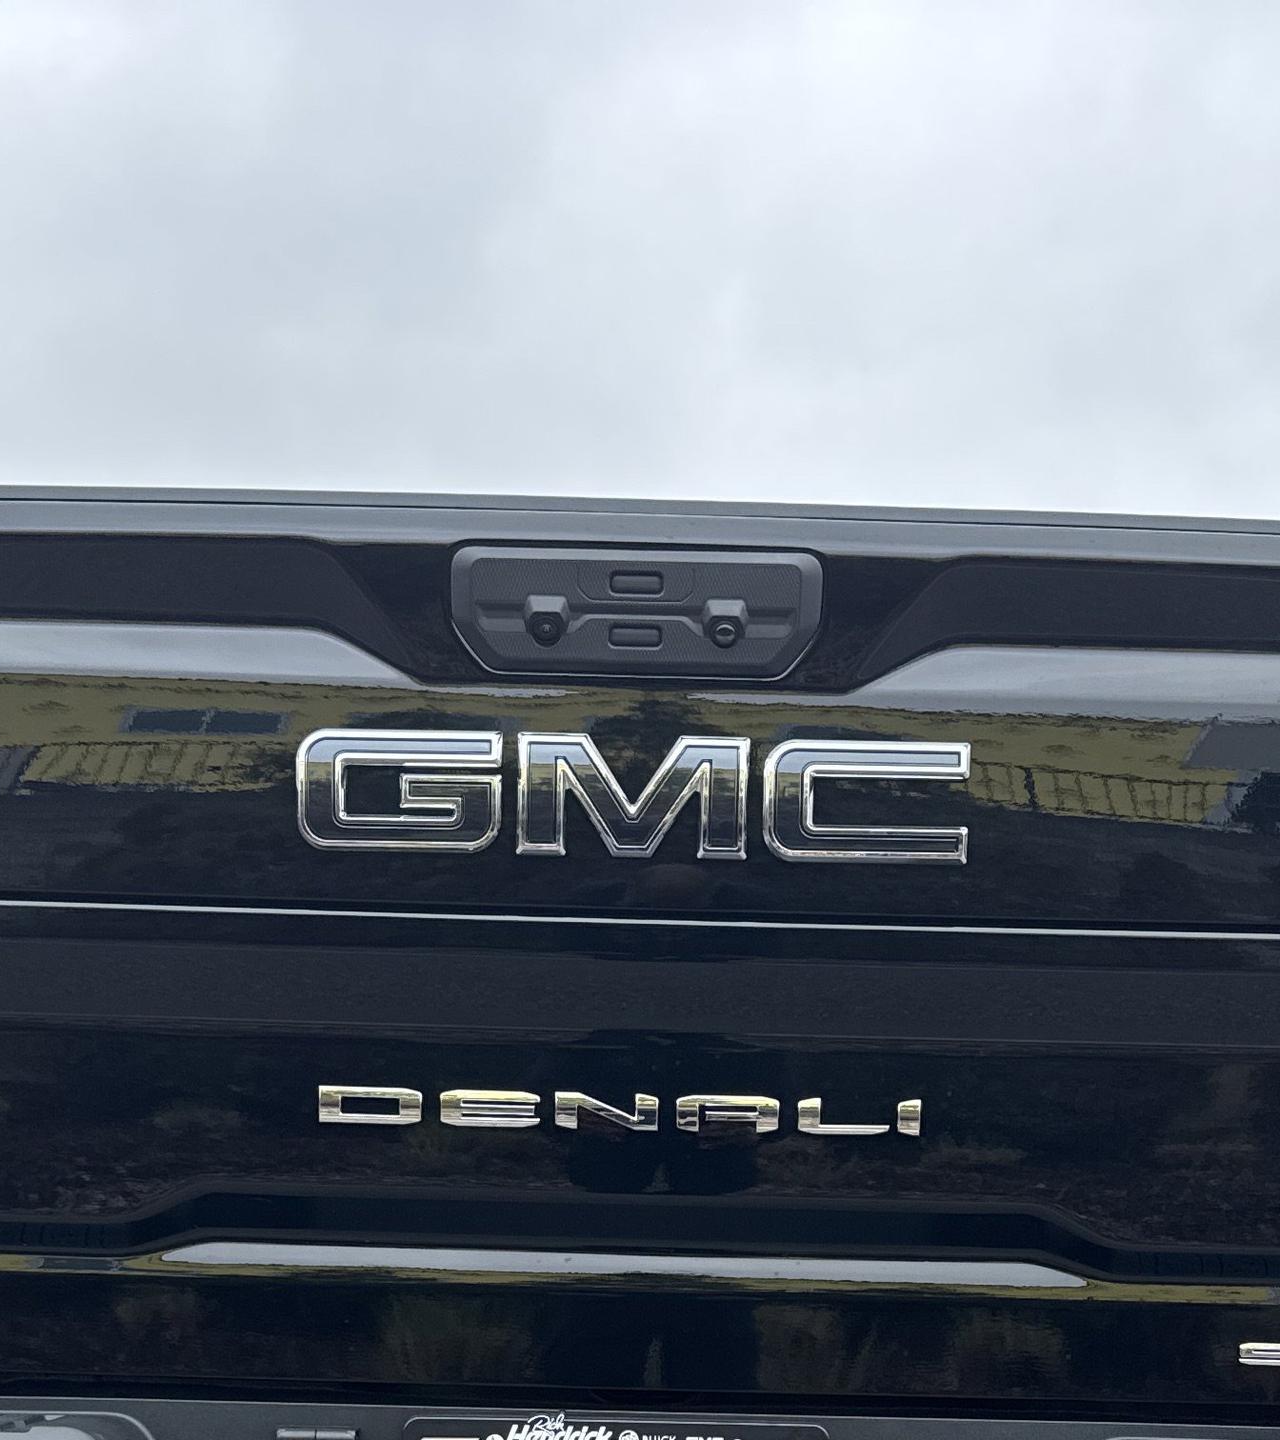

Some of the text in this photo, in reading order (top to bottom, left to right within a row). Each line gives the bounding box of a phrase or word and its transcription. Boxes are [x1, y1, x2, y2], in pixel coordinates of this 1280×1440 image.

[296, 728, 972, 864] GMC
[318, 1085, 922, 1137] DENALI
[527, 1411, 566, 1432] Rick
